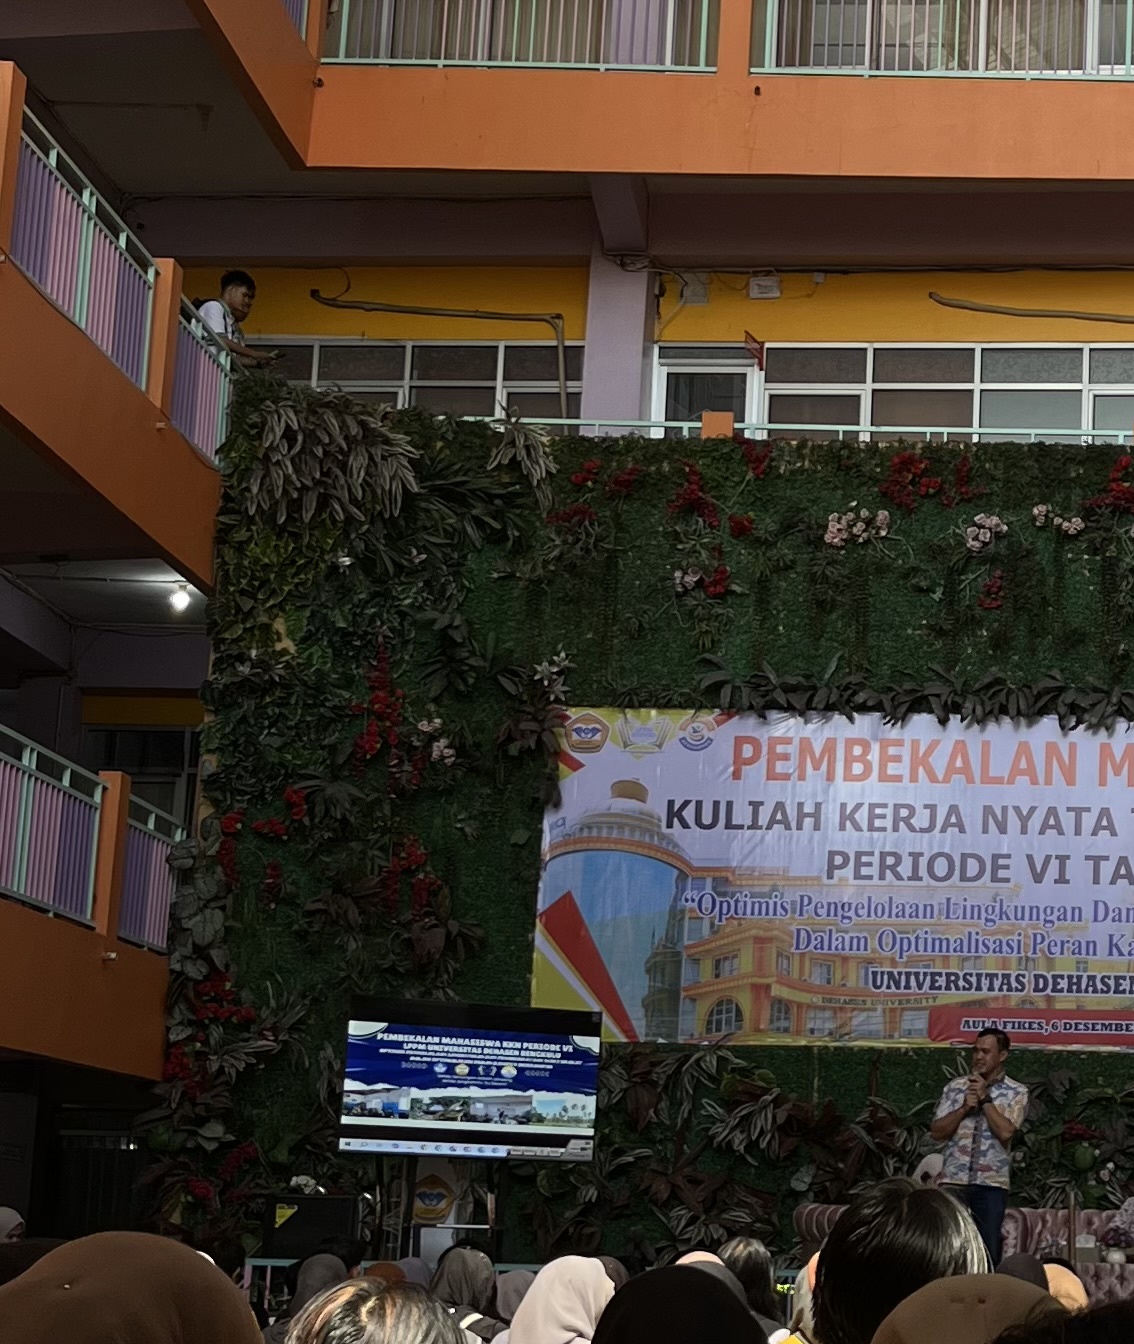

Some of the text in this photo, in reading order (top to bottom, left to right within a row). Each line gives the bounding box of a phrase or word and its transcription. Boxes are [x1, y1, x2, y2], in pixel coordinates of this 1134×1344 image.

[732, 735, 1077, 786] PEMBEKALAN
[666, 799, 822, 831] KULIAH
[838, 802, 967, 834] KERJA
[981, 804, 1118, 837] NYATA
[826, 850, 1012, 883] PERIODE
[1025, 854, 1071, 885] VI
[683, 892, 789, 923] “Optimis
[798, 894, 935, 924] Pengelolaan
[944, 896, 1083, 927] Lingkungan
[793, 928, 868, 952] Dalam
[877, 928, 1022, 960] Optimalisasi
[1031, 932, 1098, 956] Peran
[871, 969, 1026, 993] UNIVERSITAS
[871, 996, 939, 1006] UNIVERSITY
[377, 1033, 440, 1044] PEMBEKALAN
[441, 1037, 501, 1048] MAHASISWA
[1001, 1020, 1050, 1034] FIKES,
[1051, 1022, 1059, 1031] 6
